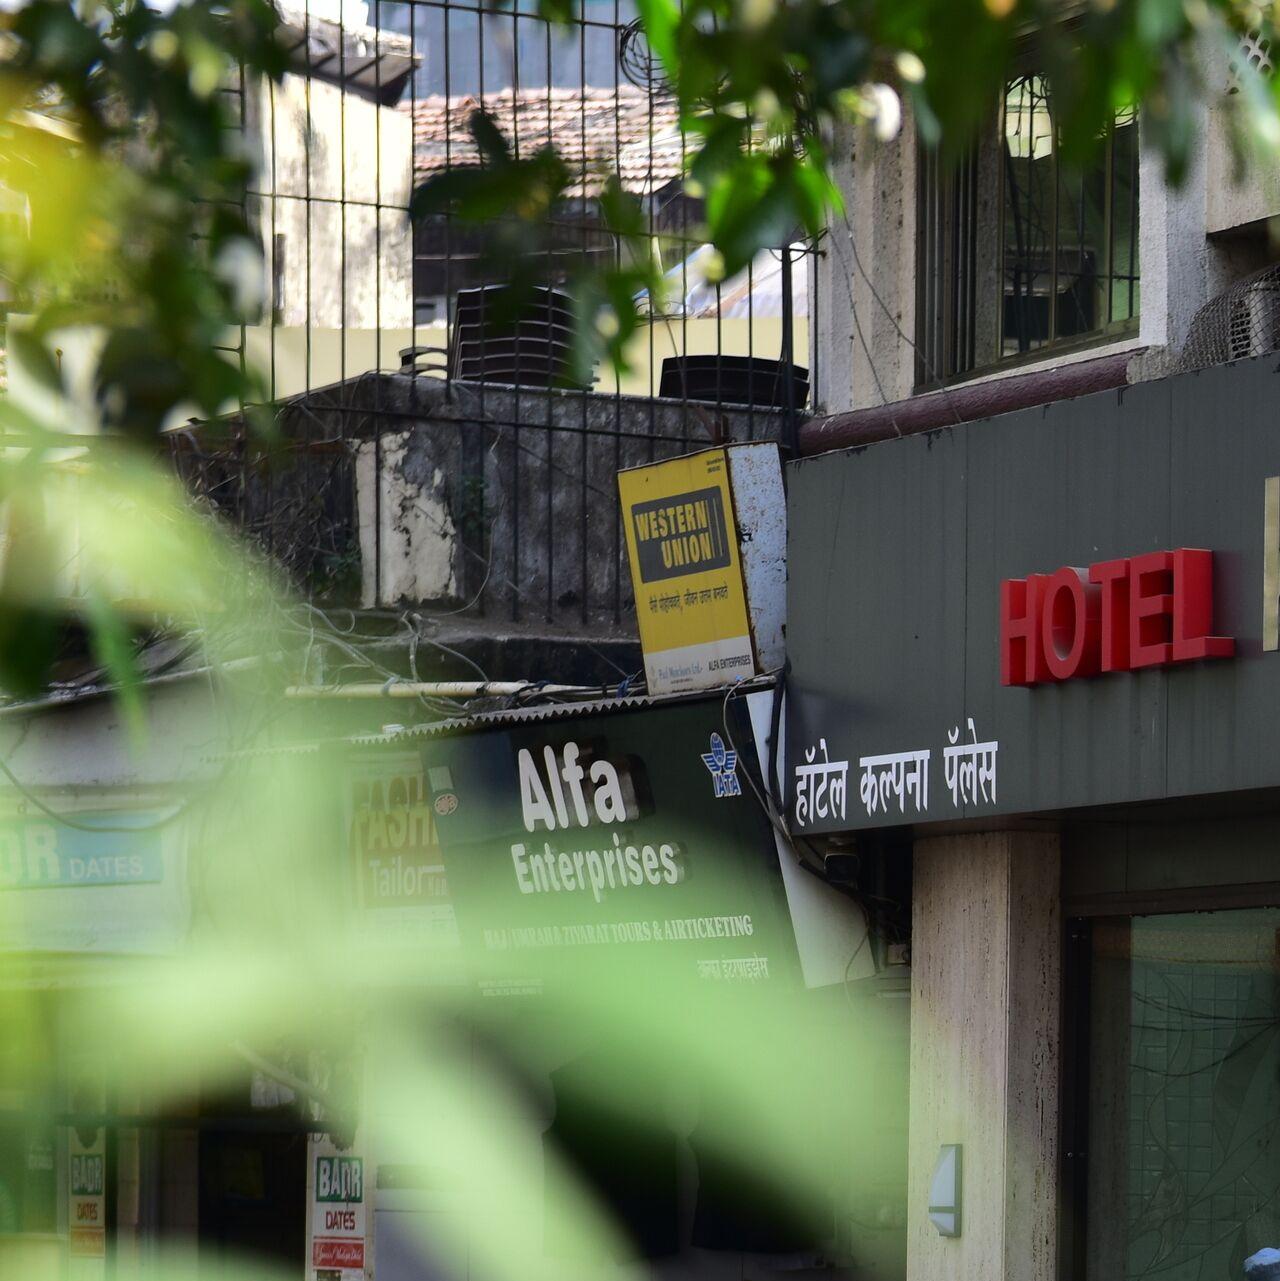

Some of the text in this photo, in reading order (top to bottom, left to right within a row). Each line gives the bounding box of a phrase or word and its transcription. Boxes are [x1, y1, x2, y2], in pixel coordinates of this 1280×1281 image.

[635, 500, 709, 541] WESTERN
[661, 532, 713, 569] UNION
[1000, 548, 1235, 688] HOTEL
[518, 741, 627, 832] Alfa
[712, 772, 742, 797] IATA
[794, 718, 999, 828] हॉटेल कल्पना पॅलेस
[69, 855, 145, 880] DATES
[369, 857, 423, 896] Tailor
[511, 833, 679, 902] Enterprises
[611, 921, 650, 943] TOURS
[652, 920, 663, 940] &
[664, 914, 753, 940] AIRTICKETING
[76, 1202, 98, 1221] DATES
[325, 1211, 356, 1231] DATES
